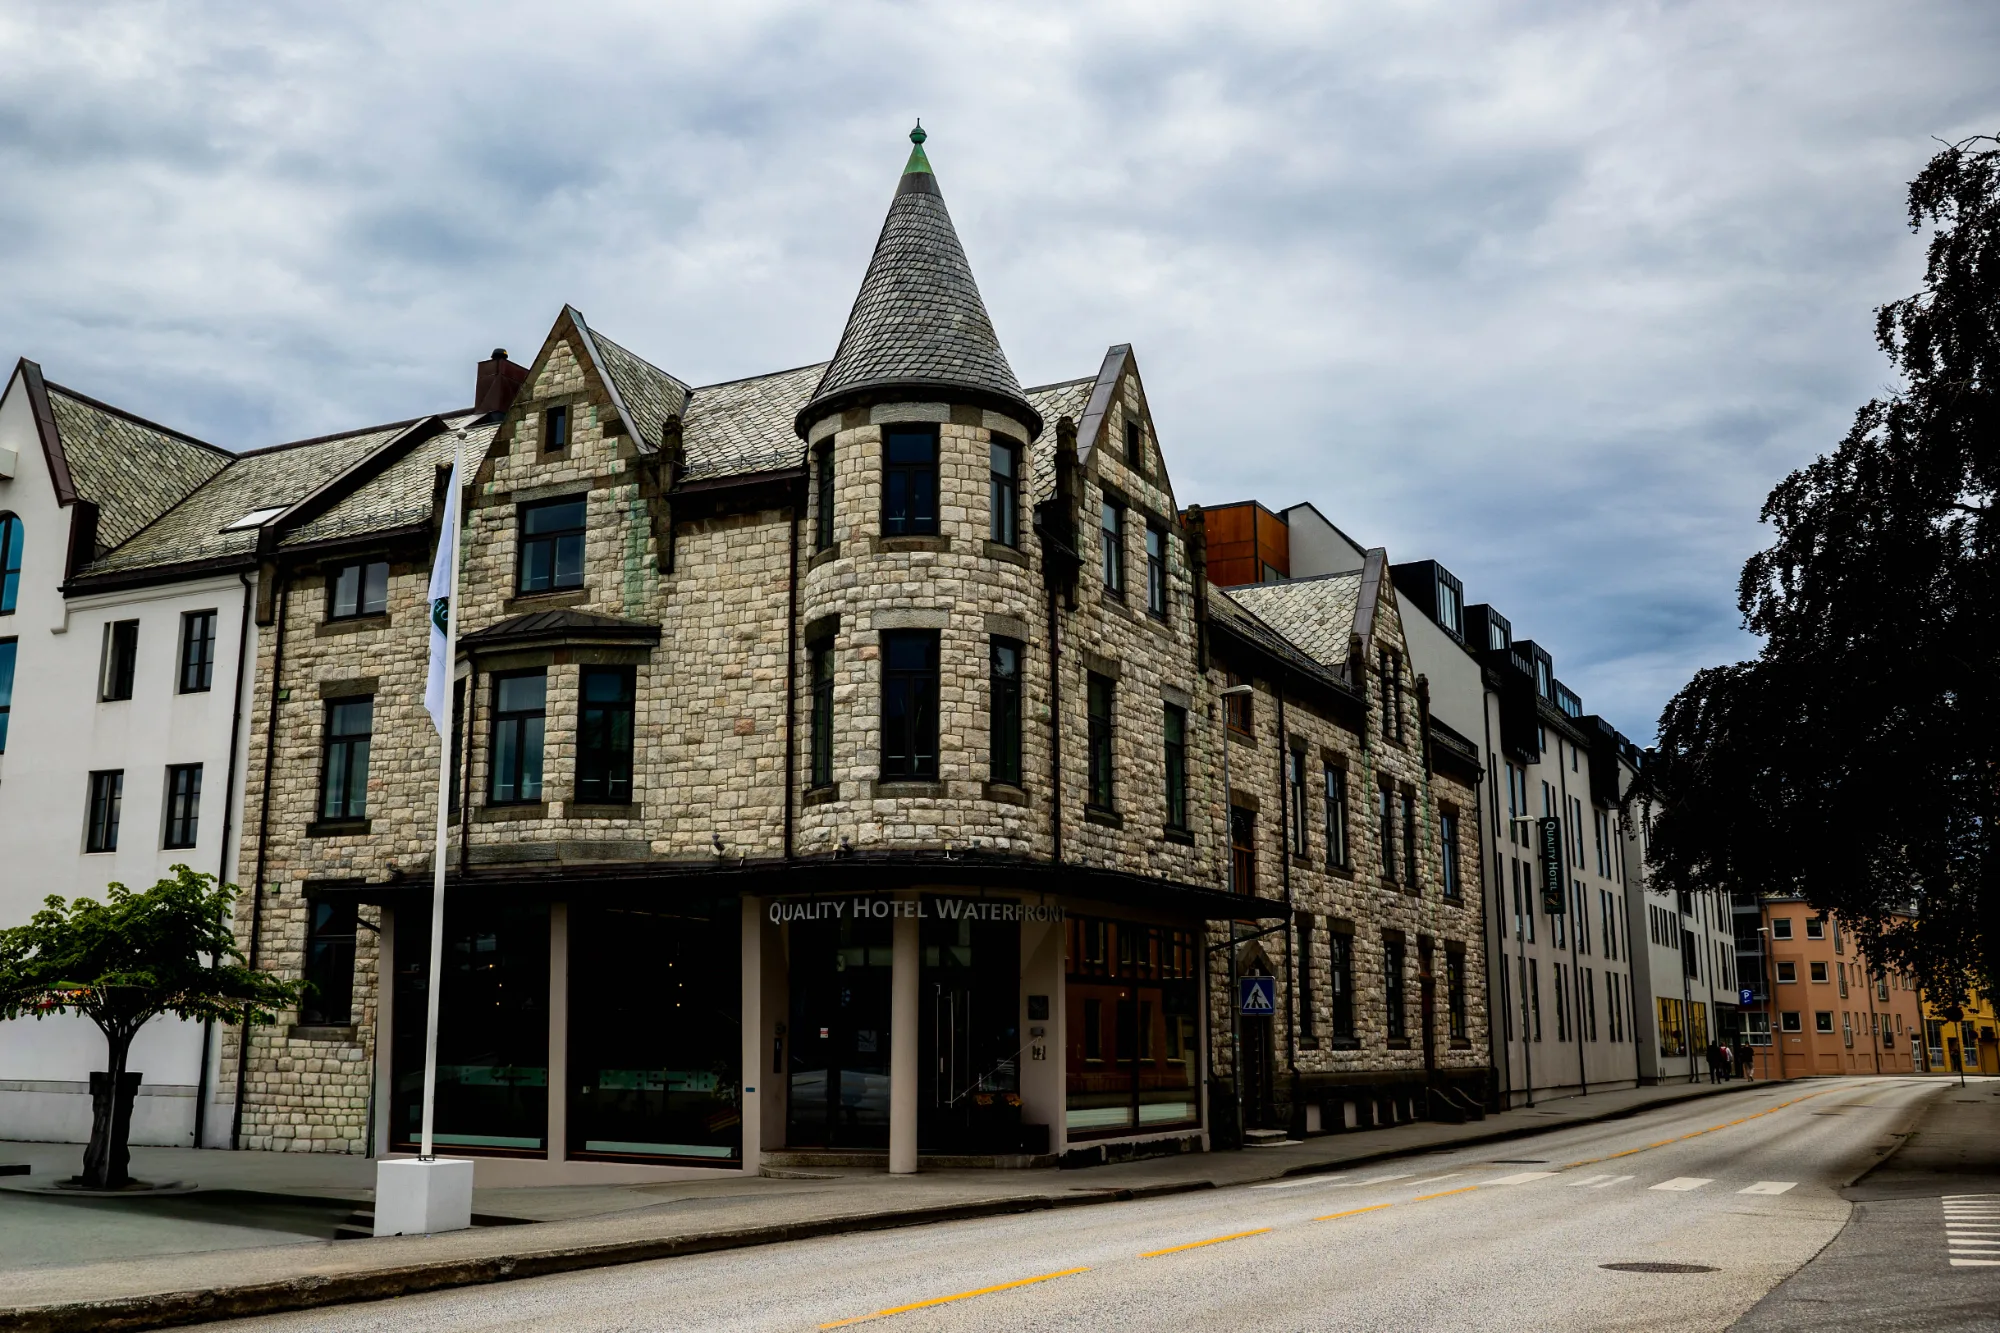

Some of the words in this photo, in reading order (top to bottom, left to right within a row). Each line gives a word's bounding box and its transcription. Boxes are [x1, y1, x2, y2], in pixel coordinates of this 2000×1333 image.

[1545, 821, 1556, 860] QUALITY
[1548, 861, 1559, 891] HOTEL
[769, 901, 846, 925] QUALITY
[853, 898, 929, 918] HOTEL
[935, 898, 1067, 923] WATERFRONT
